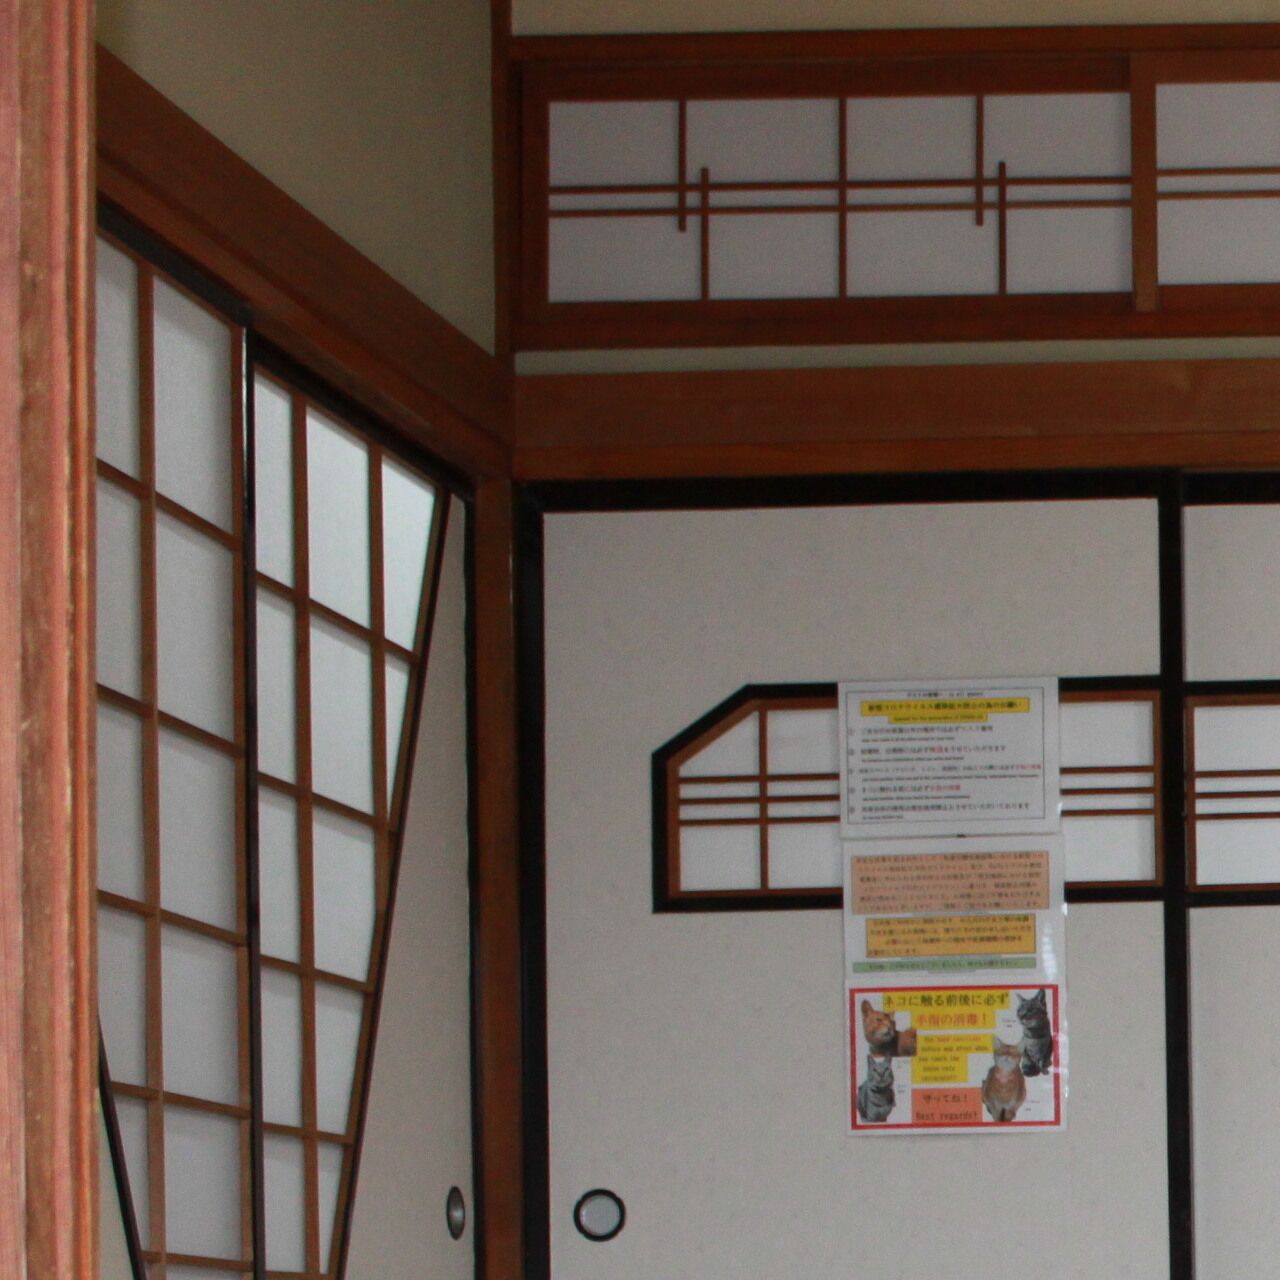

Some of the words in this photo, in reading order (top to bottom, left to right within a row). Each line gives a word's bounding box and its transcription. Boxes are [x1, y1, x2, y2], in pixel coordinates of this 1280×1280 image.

[884, 992, 1009, 1008] ネコに触る前後に必ず
